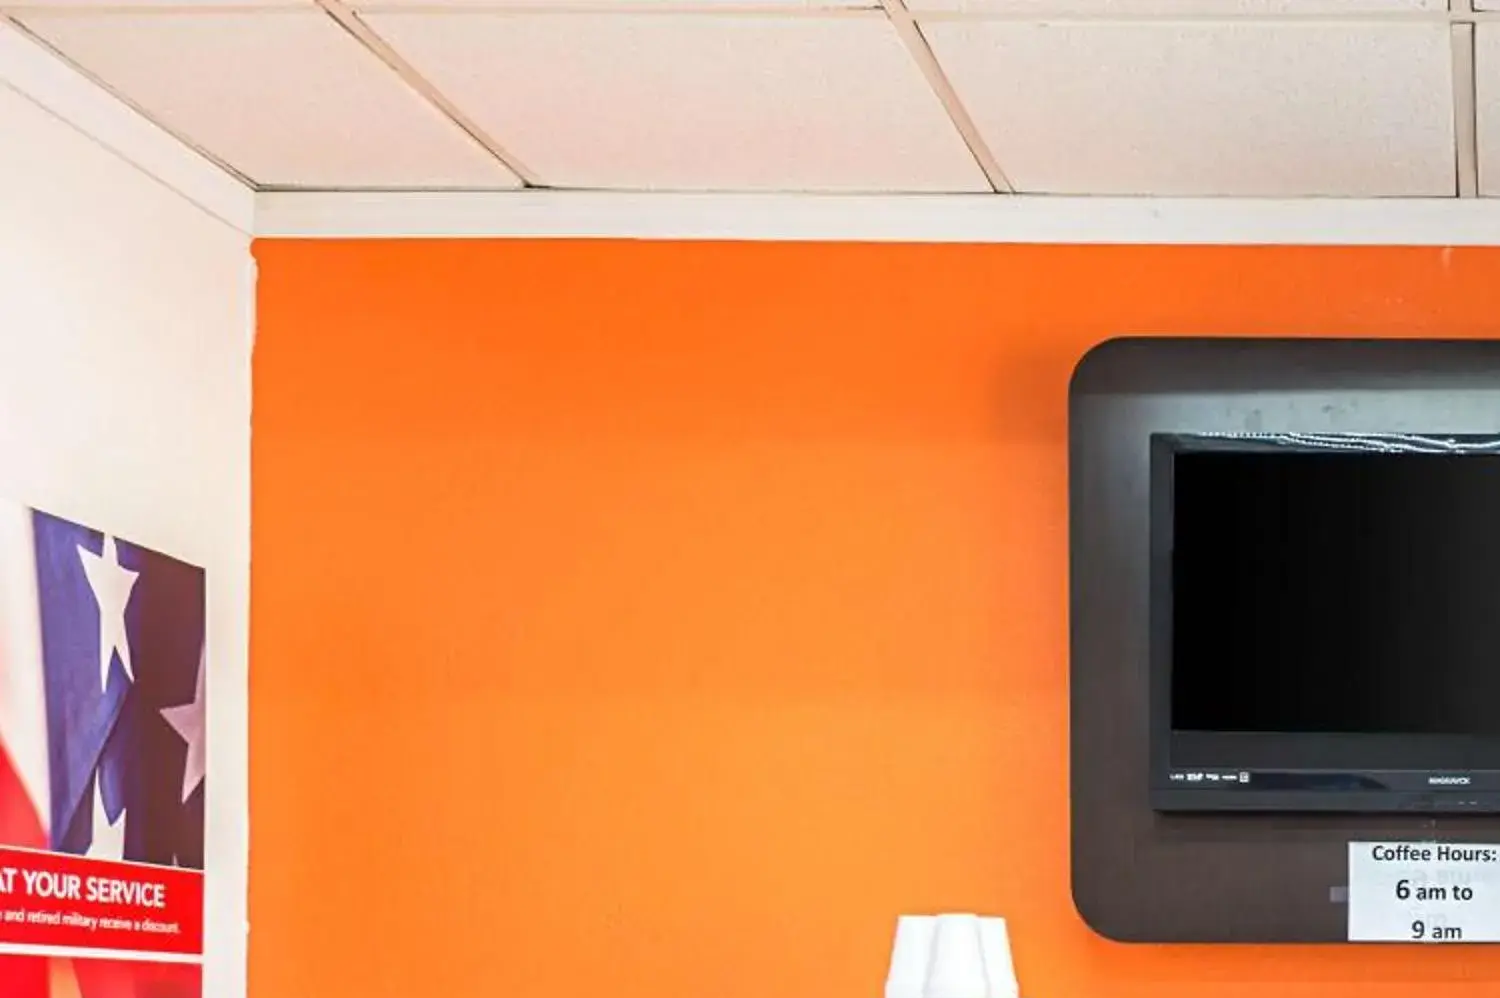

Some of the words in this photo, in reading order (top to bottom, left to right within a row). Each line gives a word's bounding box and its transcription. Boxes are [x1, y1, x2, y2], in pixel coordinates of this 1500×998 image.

[1372, 845, 1431, 861] Coffee
[1437, 846, 1497, 862] Hours:
[22, 868, 81, 900] YOUR
[86, 876, 166, 908] SERVICE
[1395, 879, 1410, 901] 6
[1416, 886, 1446, 901] am
[1452, 885, 1473, 901] to
[4, 908, 25, 922] and
[27, 910, 61, 925] retired
[62, 911, 98, 931] military
[1411, 920, 1425, 940] 9
[1432, 926, 1462, 940] am
